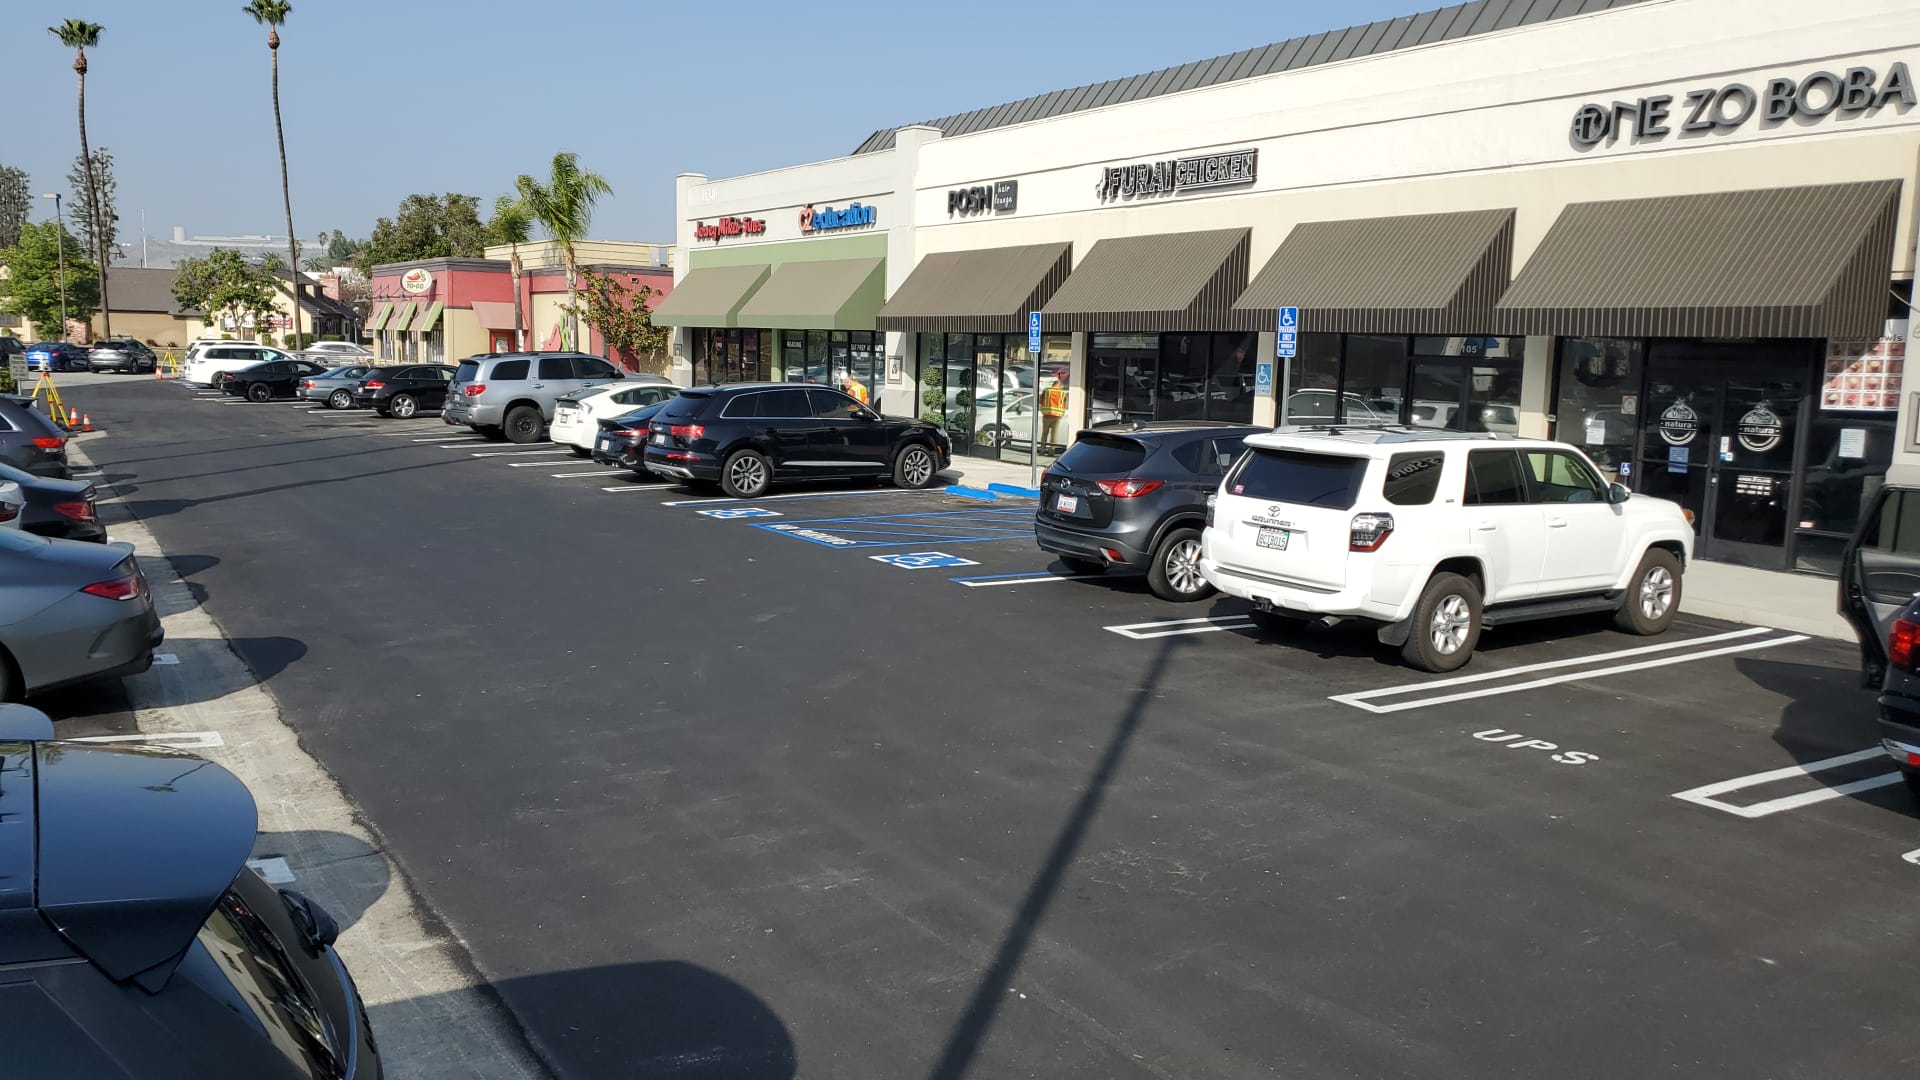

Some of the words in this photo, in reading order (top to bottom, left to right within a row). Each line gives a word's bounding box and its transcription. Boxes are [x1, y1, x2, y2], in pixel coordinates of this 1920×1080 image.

[1571, 94, 1673, 144] ONE
[1681, 82, 1757, 132] ZO
[1764, 61, 1919, 121] BOBA
[1108, 160, 1175, 197] FURAI
[1176, 153, 1254, 185] CHICKEN
[948, 185, 993, 214] POSH
[1462, 344, 1478, 354] 105
[1664, 421, 1692, 429] natura
[1743, 426, 1775, 434] natura
[1473, 728, 1600, 765] UPS
